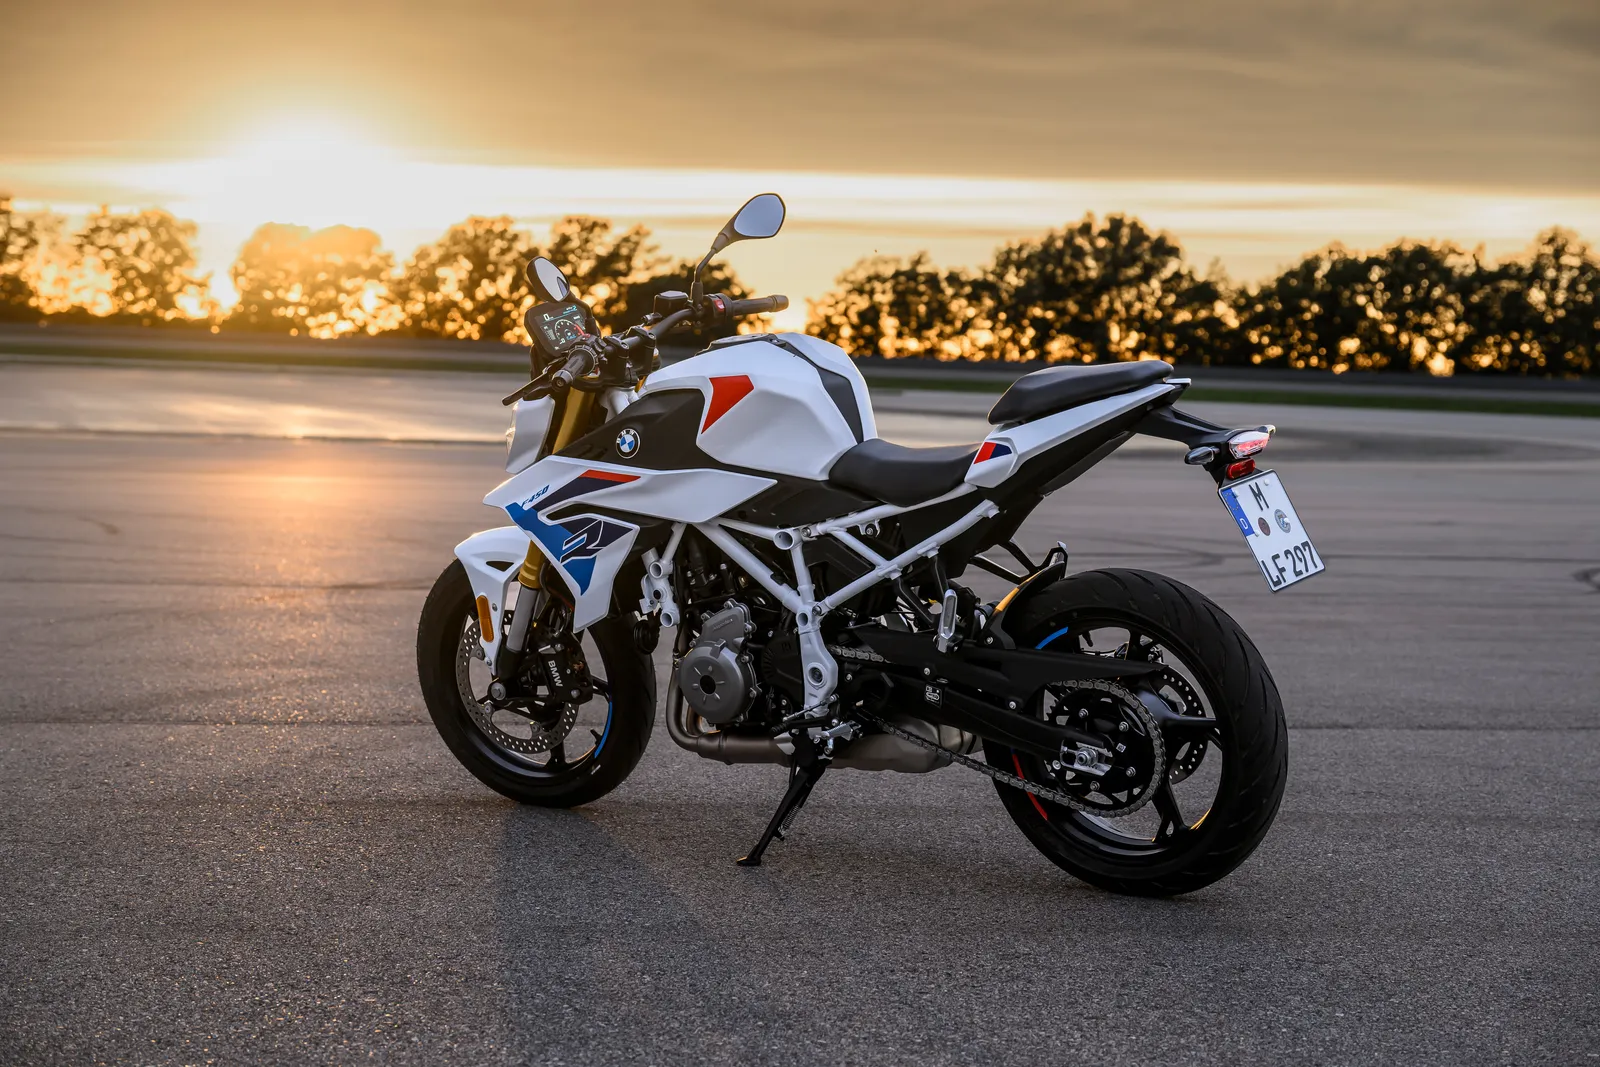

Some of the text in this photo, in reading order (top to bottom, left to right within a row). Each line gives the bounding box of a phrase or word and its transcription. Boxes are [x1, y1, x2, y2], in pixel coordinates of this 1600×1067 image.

[1249, 482, 1270, 512] M
[1240, 518, 1248, 530] D
[1261, 540, 1318, 588] LF 297
[548, 660, 563, 687] BMW
